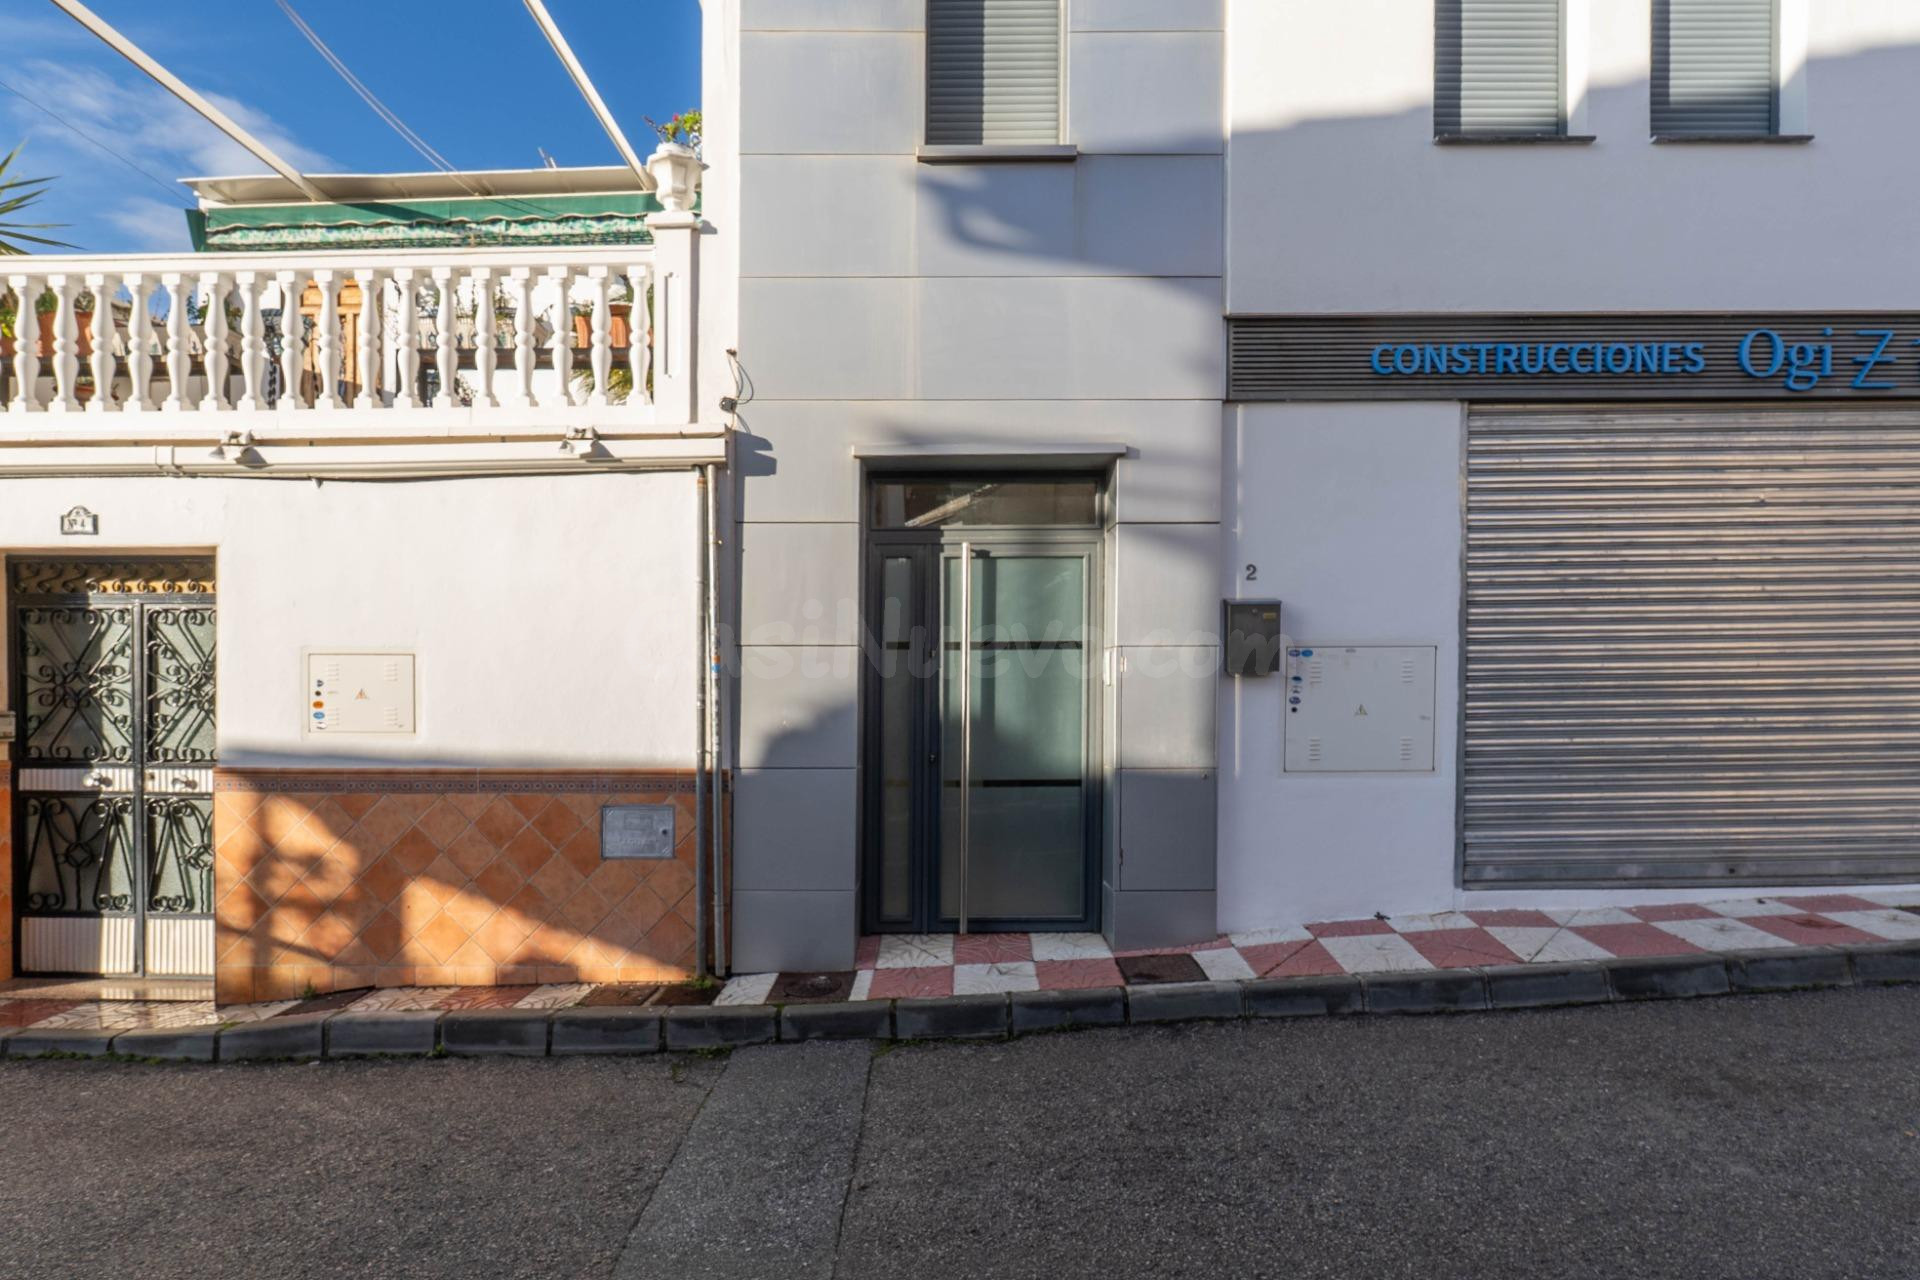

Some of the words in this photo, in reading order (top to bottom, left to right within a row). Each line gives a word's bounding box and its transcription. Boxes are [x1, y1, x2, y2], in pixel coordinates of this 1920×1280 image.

[1371, 342, 1706, 375] CONSTRUCCIONES
[1738, 327, 1834, 391] Ogi
[1246, 564, 1257, 581] 2
